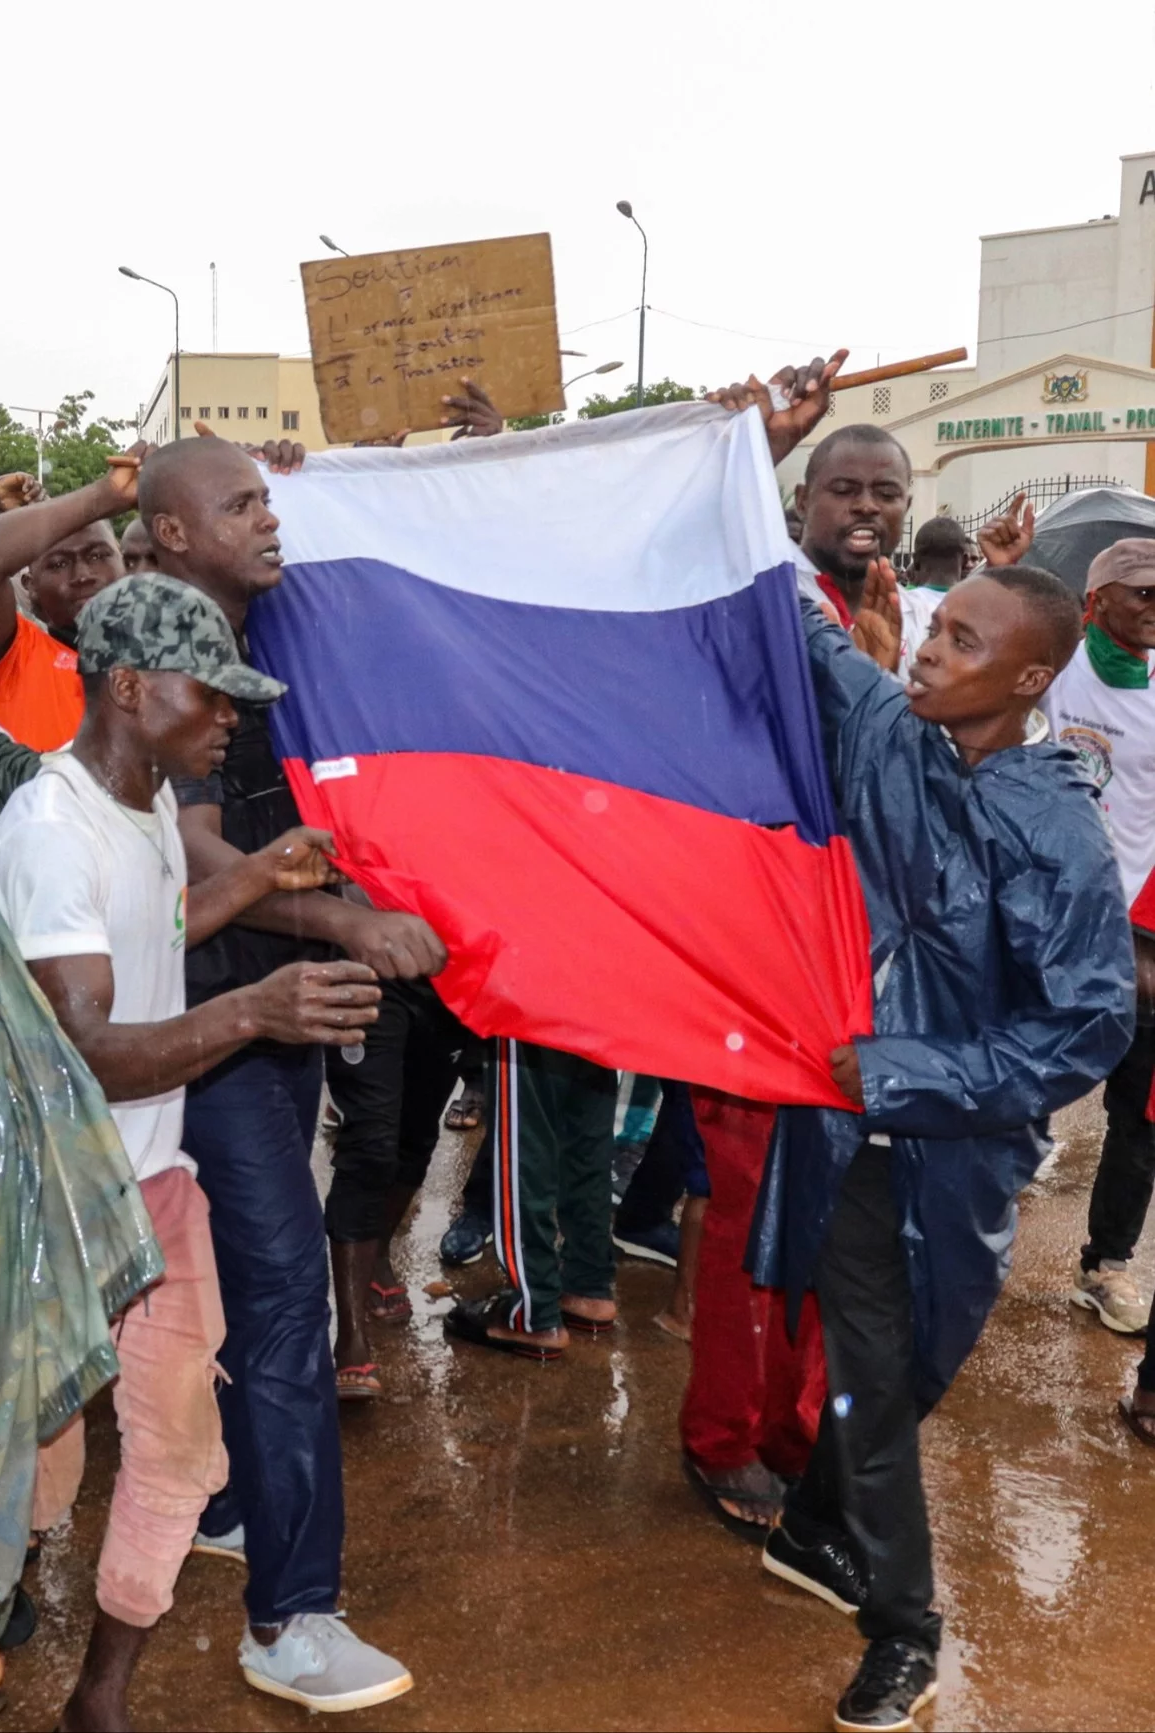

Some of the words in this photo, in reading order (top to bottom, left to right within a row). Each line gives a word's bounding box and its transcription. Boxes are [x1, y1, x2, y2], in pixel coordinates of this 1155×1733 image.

[315, 254, 461, 301] Soutien
[937, 416, 1024, 441] FRATERNITE
[1046, 411, 1106, 434] TRAVAIL
